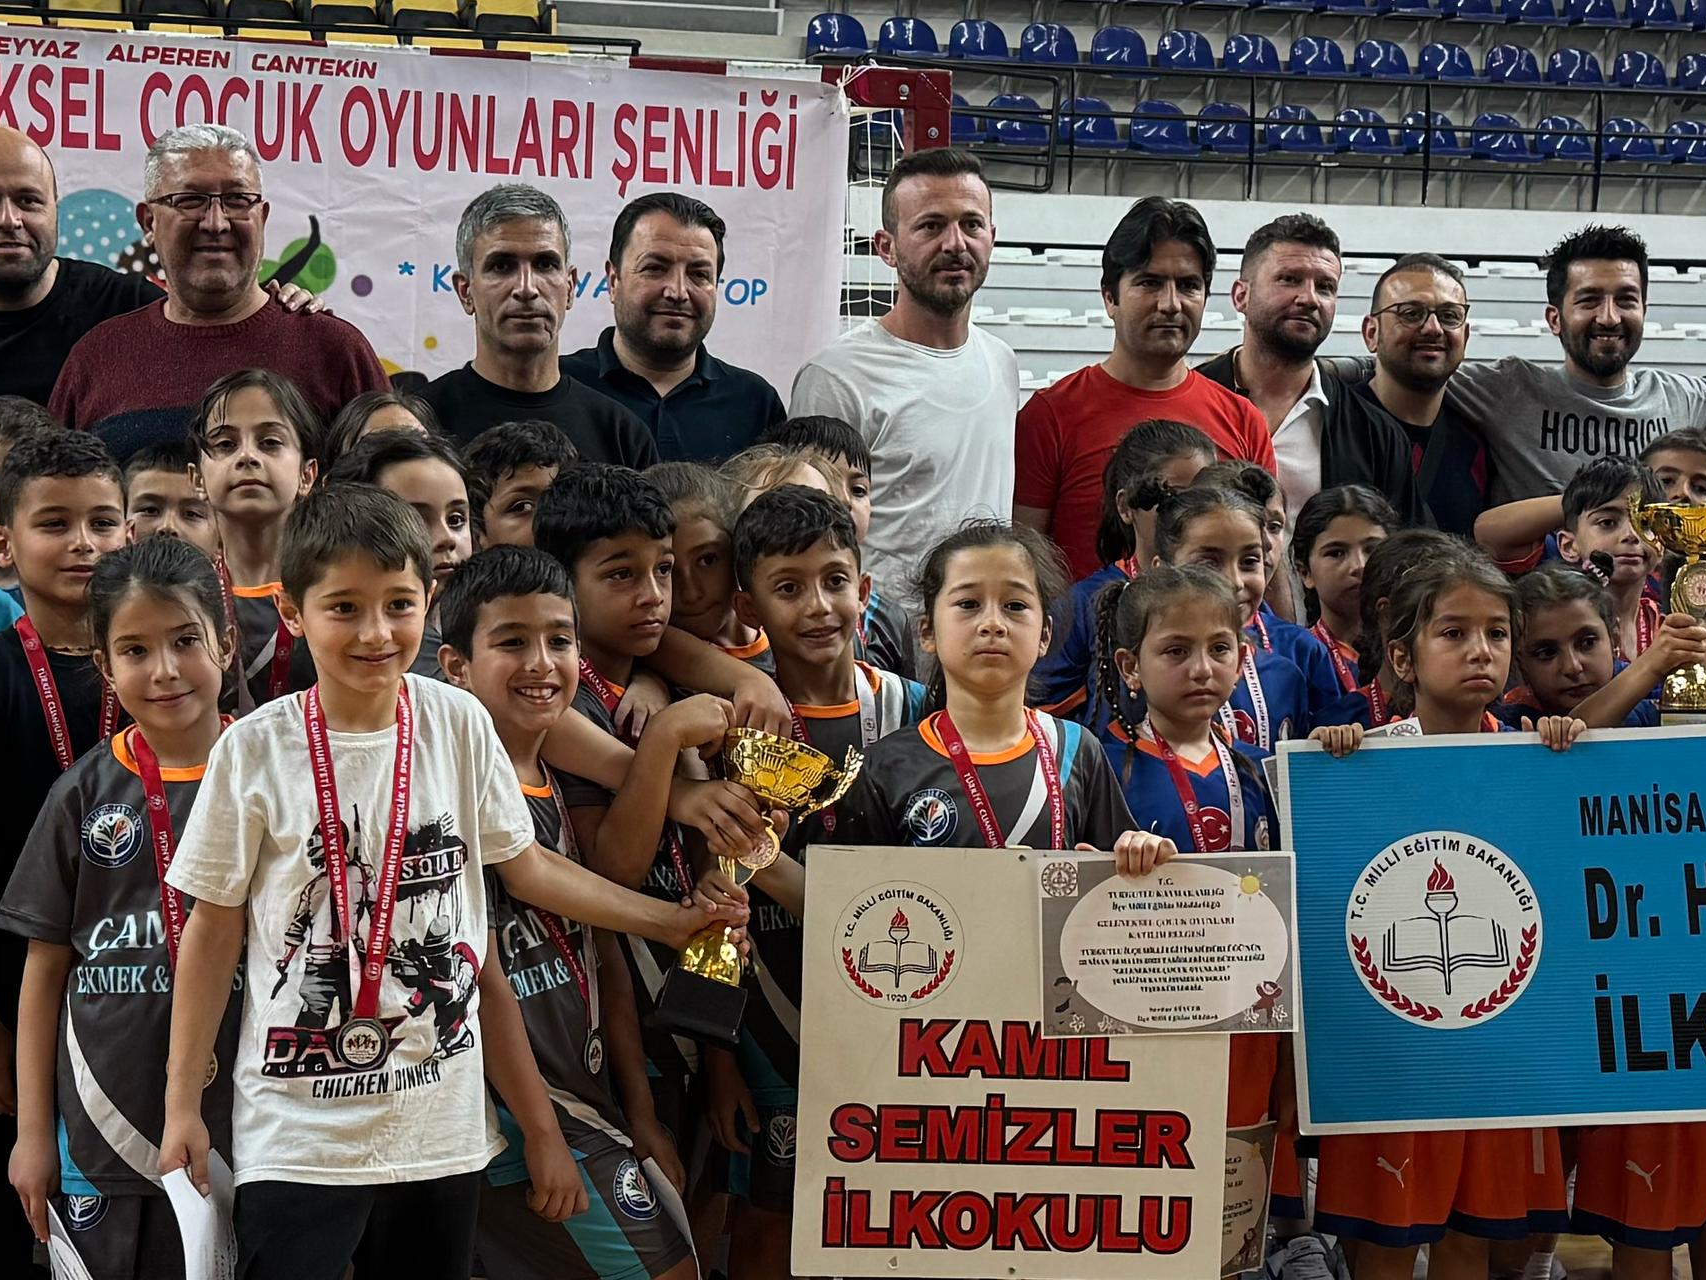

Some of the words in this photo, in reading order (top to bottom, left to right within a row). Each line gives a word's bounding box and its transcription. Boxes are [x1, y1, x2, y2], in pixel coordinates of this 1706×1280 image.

[105, 42, 231, 71] ALPEREN
[250, 52, 378, 80] CANTEKİN
[339, 85, 595, 181] OYUNLARI
[612, 90, 799, 199] ŞENLİĞİ
[1579, 783, 1705, 836] MANİSA
[1351, 890, 1371, 920] T.C.
[1365, 848, 1402, 883] MİLLİ
[1403, 836, 1461, 858] EĞİTİM
[1465, 843, 1533, 914] BAKANLIĞI
[1581, 866, 1662, 941] Dr.
[312, 1071, 389, 1099] CHICKEN
[395, 1060, 441, 1093] DINNER
[826, 1093, 1196, 1172] SEMİZLER
[821, 1176, 1193, 1257] İLKOKULU
